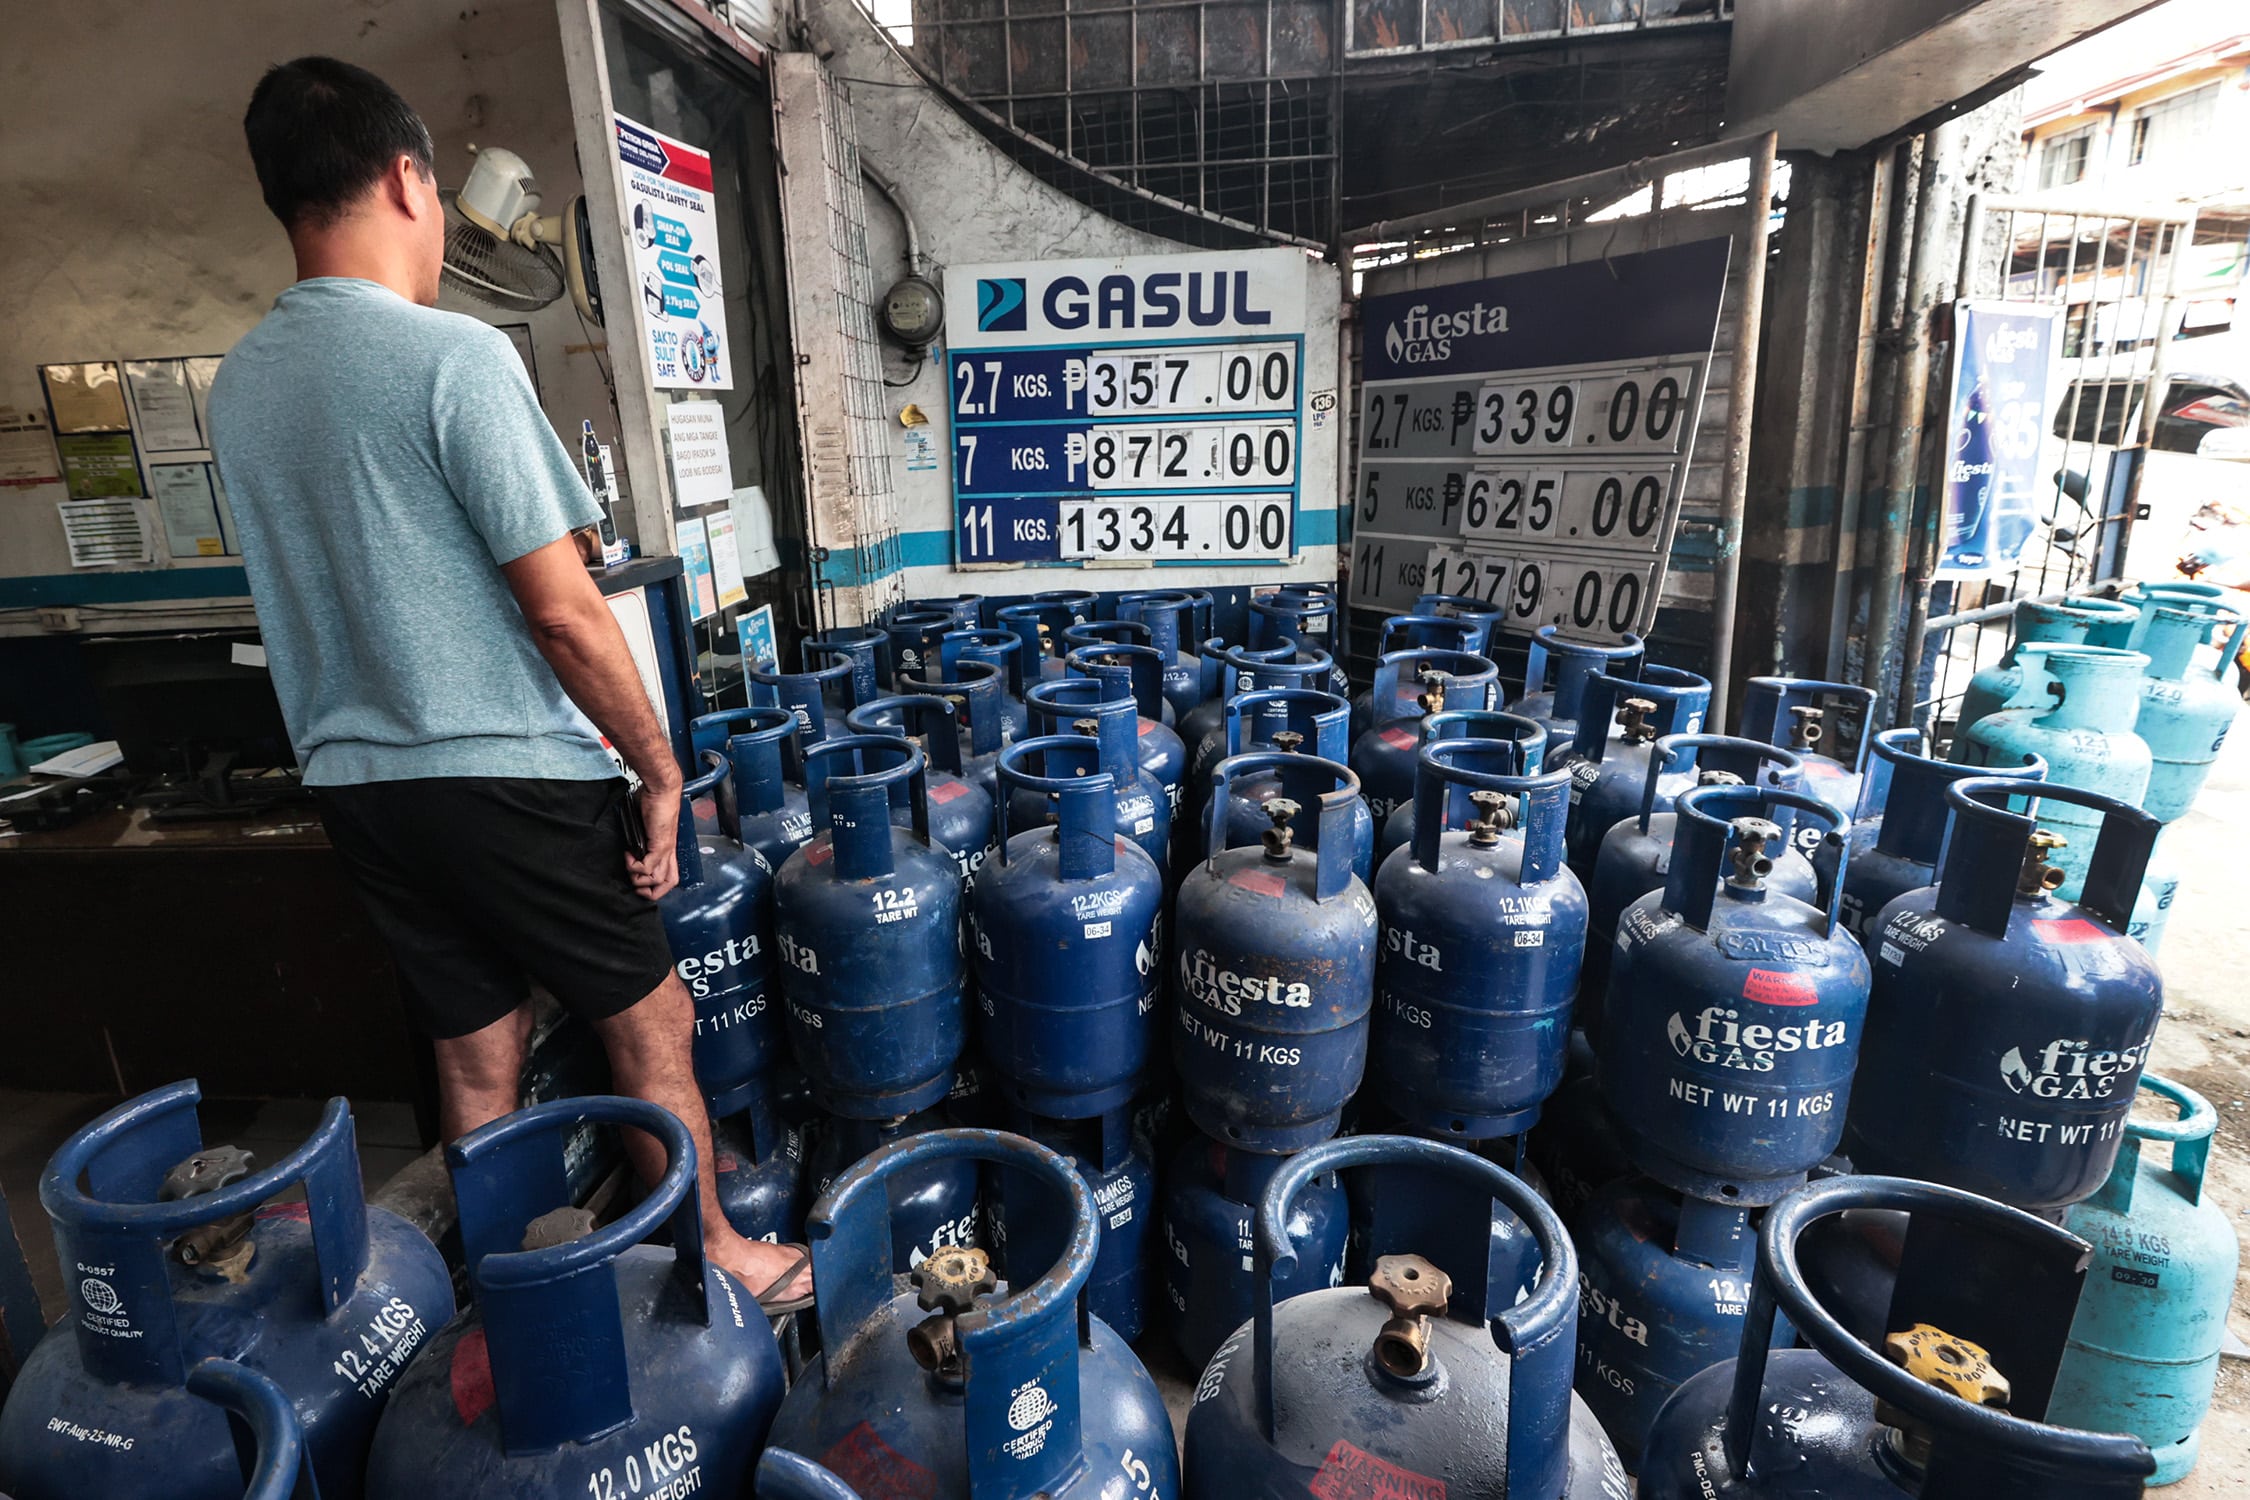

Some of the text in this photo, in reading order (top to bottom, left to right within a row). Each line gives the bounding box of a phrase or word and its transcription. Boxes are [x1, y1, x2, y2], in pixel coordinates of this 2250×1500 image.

[631, 179, 705, 213] GASULISTA SAFETY SEAL
[665, 233, 680, 247] SEAL
[674, 263, 690, 276] SEAL
[683, 298, 698, 310] SEAL
[1042, 270, 1271, 330] GASUL
[652, 329, 678, 345] SAKTO
[1403, 302, 1508, 342] fiesta
[655, 346, 676, 362] SULIT
[1405, 339, 1451, 363] GAS
[657, 363, 677, 378] SAFE
[957, 361, 1002, 415] 2.7
[1013, 374, 1052, 398] KGS.
[1315, 395, 1332, 410] 136
[1368, 394, 1409, 449] 2.7
[1413, 408, 1444, 432] KGS.
[959, 435, 978, 486] 7
[1011, 447, 1050, 471] KGS.
[1364, 471, 1379, 522] 5
[1405, 487, 1437, 512] KGS.
[964, 505, 994, 557] 11
[1013, 519, 1051, 541] KGS.
[1361, 543, 1384, 597] 11
[2148, 684, 2183, 701] 12.0
[1580, 765, 1600, 782] KGS
[799, 812, 812, 827] KG
[872, 887, 916, 911] 12.2
[1076, 907, 1122, 920] TARE WEIGHT
[875, 906, 919, 924] TARE WT
[1504, 912, 1552, 926] TARE WEIGHT
[1892, 910, 1921, 927] 12.2
[1910, 919, 1945, 941] KGS
[1086, 925, 1110, 936] 06-34
[1517, 932, 1541, 945] 08-34
[1884, 924, 1928, 952] TARE WEIGHT
[677, 934, 761, 981] esta
[779, 933, 820, 975] sta
[1387, 926, 1442, 972] sta
[1194, 949, 1312, 1008] fiesta
[1190, 980, 1242, 1016] GAS
[694, 993, 767, 1036] T 11 KGS
[1395, 999, 1432, 1029] KGS
[1696, 1006, 1846, 1052] fiesta
[1179, 1006, 1301, 1066] NET WT 11 KGS
[1692, 1041, 1775, 1072] GAS
[2040, 1039, 2152, 1077] fiest
[1670, 1078, 1833, 1117] NET WT 11 KGS
[2032, 1075, 2115, 1099] GAS
[1999, 1116, 2115, 1145] NET WT 11
[1099, 1191, 1135, 1216] TARE WEIGHT
[2104, 1246, 2169, 1269] TARE WEIGHT
[2138, 1233, 2170, 1255] KGS
[77, 1262, 115, 1276] Q-0557
[86, 1312, 130, 1328] CERTIFIED
[1714, 1303, 1742, 1315] TARE
[81, 1319, 143, 1338] PRODUCT QUALITY
[334, 1297, 415, 1384] 12.4 KGS
[358, 1317, 427, 1399] TARE WEIGHT
[1580, 1343, 1634, 1396] 11 KGS
[1199, 1358, 1231, 1402] KGS
[47, 1417, 134, 1451] EWT-Aug-25-NR-G
[1003, 1420, 1053, 1453] CERTIFIED
[1012, 1433, 1046, 1457] PRODUCT
[589, 1425, 697, 1500] 12.0 KGS
[1016, 1442, 1044, 1460] UALITY
[1337, 1445, 1447, 1500] WARNING
